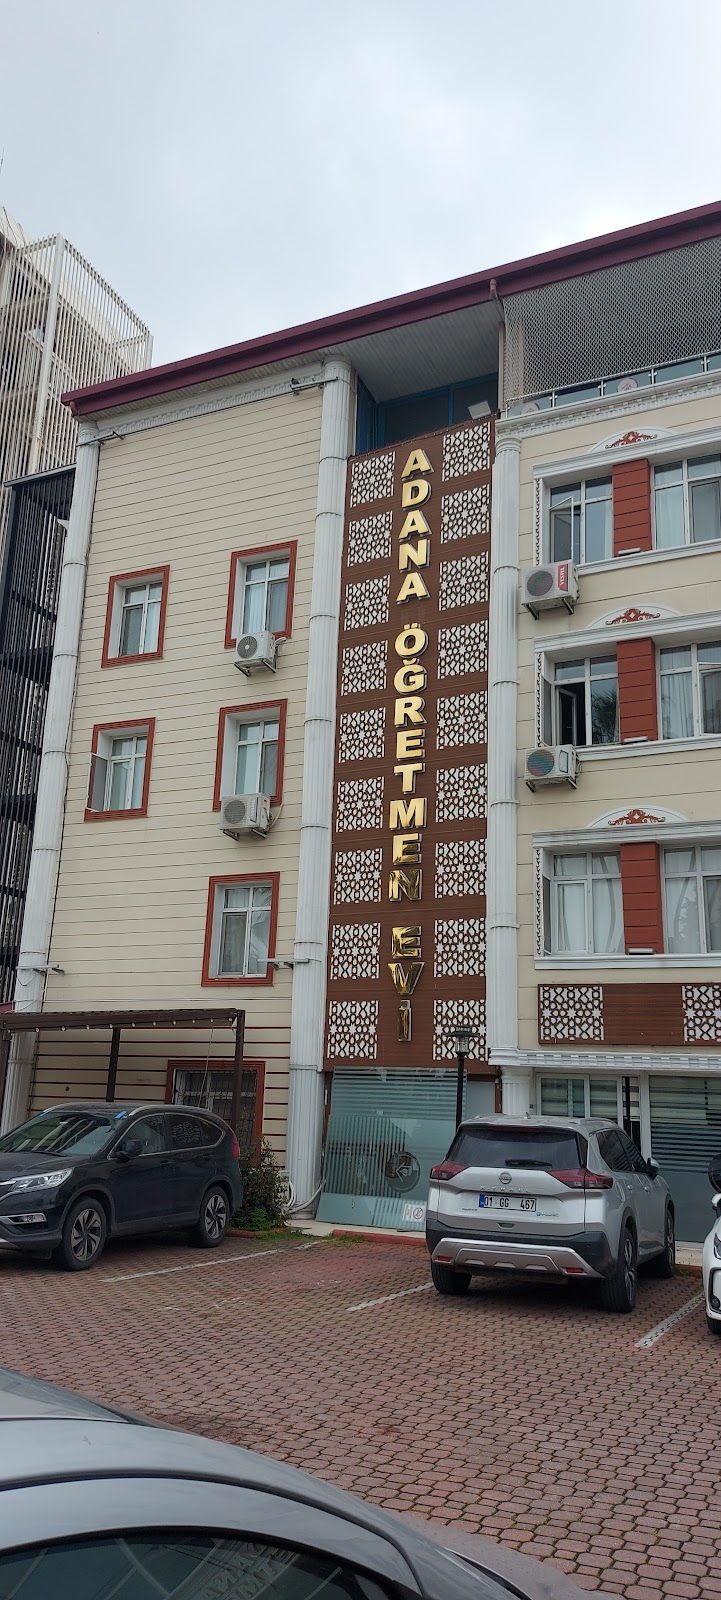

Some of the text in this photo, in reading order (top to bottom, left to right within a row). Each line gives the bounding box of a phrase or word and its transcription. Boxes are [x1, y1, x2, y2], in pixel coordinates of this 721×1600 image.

[388, 448, 433, 1042] ADANA ÖĞRETMEN EVİ
[484, 1196, 535, 1210] 01 GG 467
